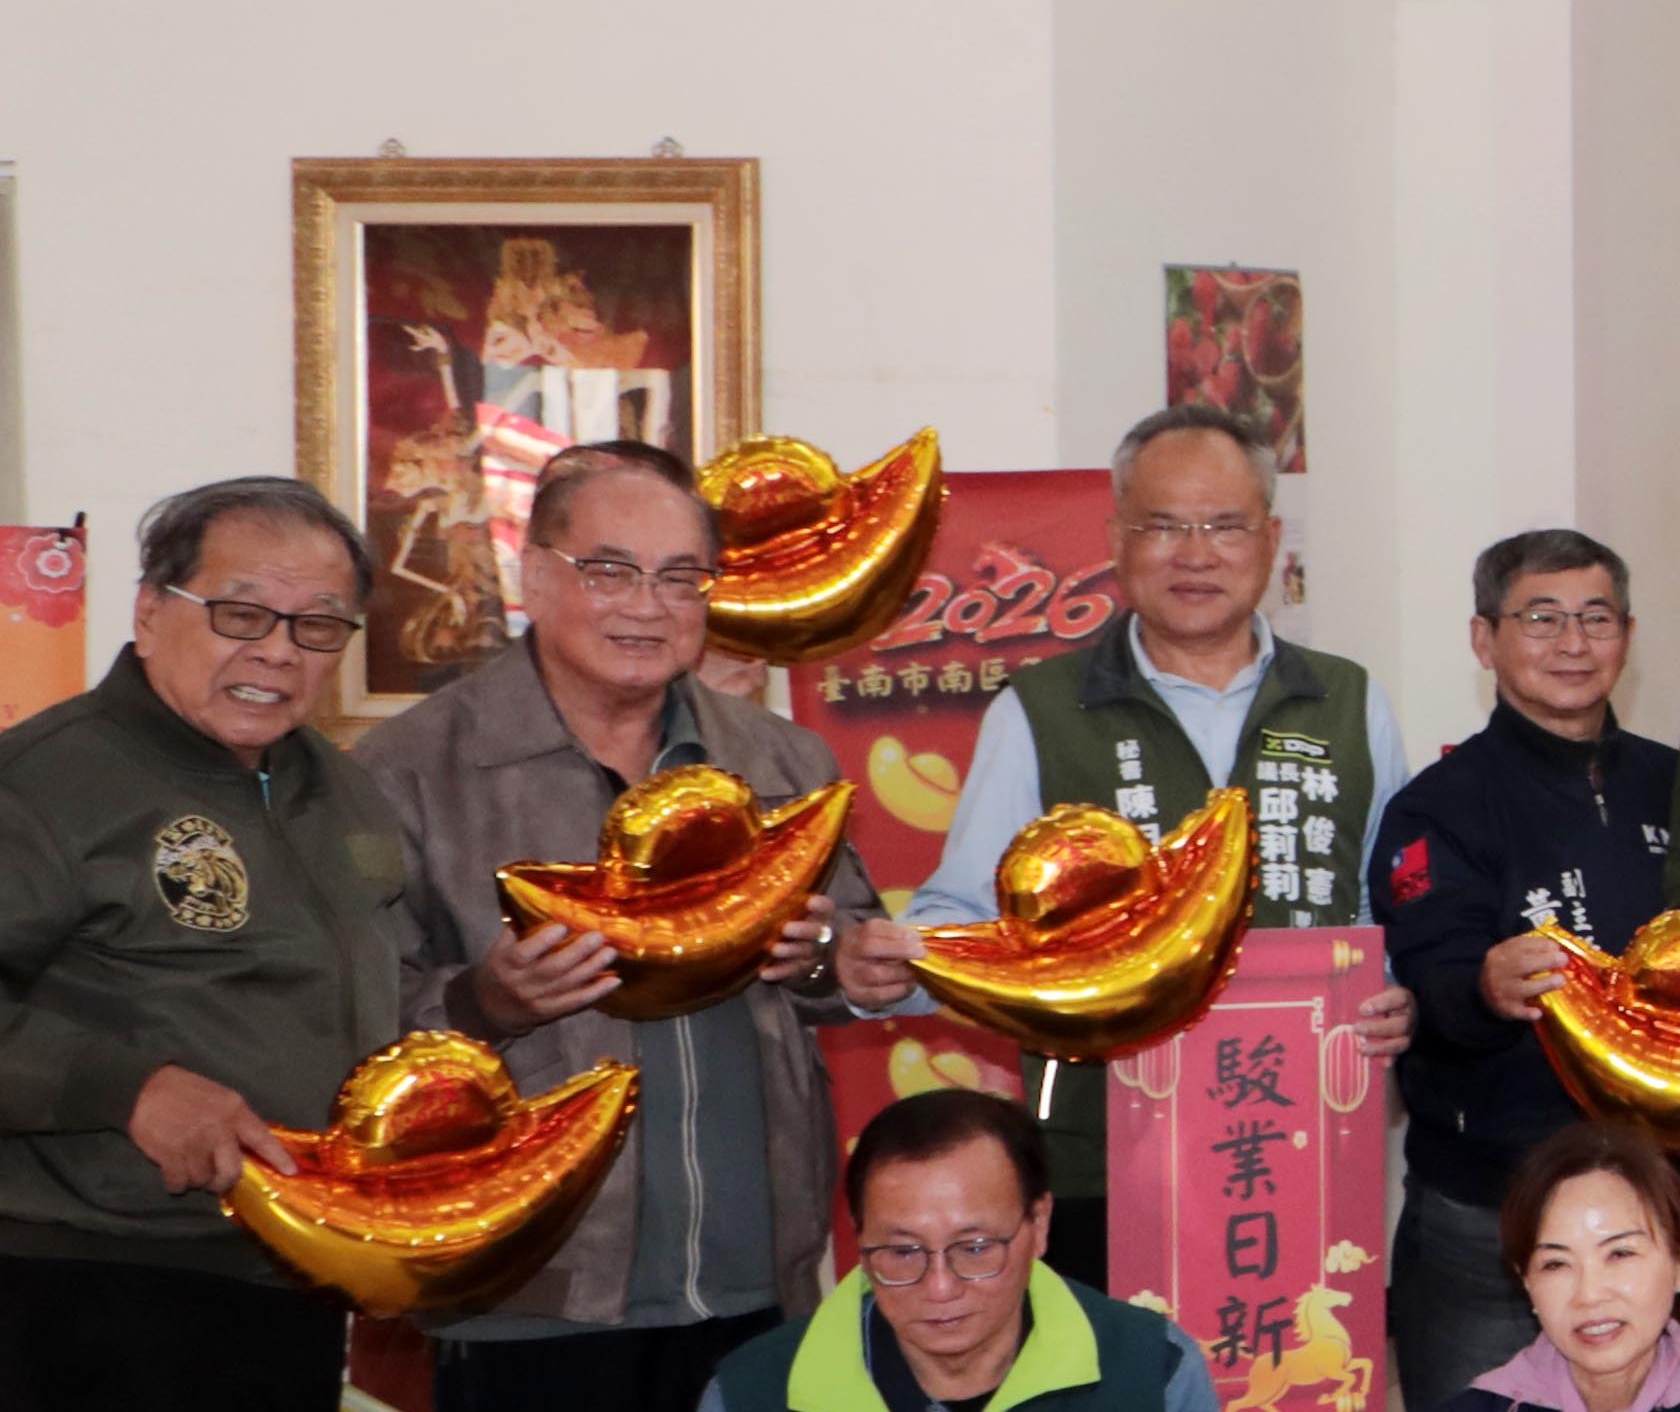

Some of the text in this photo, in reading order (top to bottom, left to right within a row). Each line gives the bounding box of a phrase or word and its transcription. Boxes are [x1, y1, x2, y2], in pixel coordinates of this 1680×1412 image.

[869, 559, 1118, 653] 2026
[817, 656, 1042, 704] 臺南市南區
[1257, 787, 1301, 902] 邱莉莉
[1301, 767, 1339, 906] 林俊憲
[1206, 1033, 1296, 1371] 駿業日新
